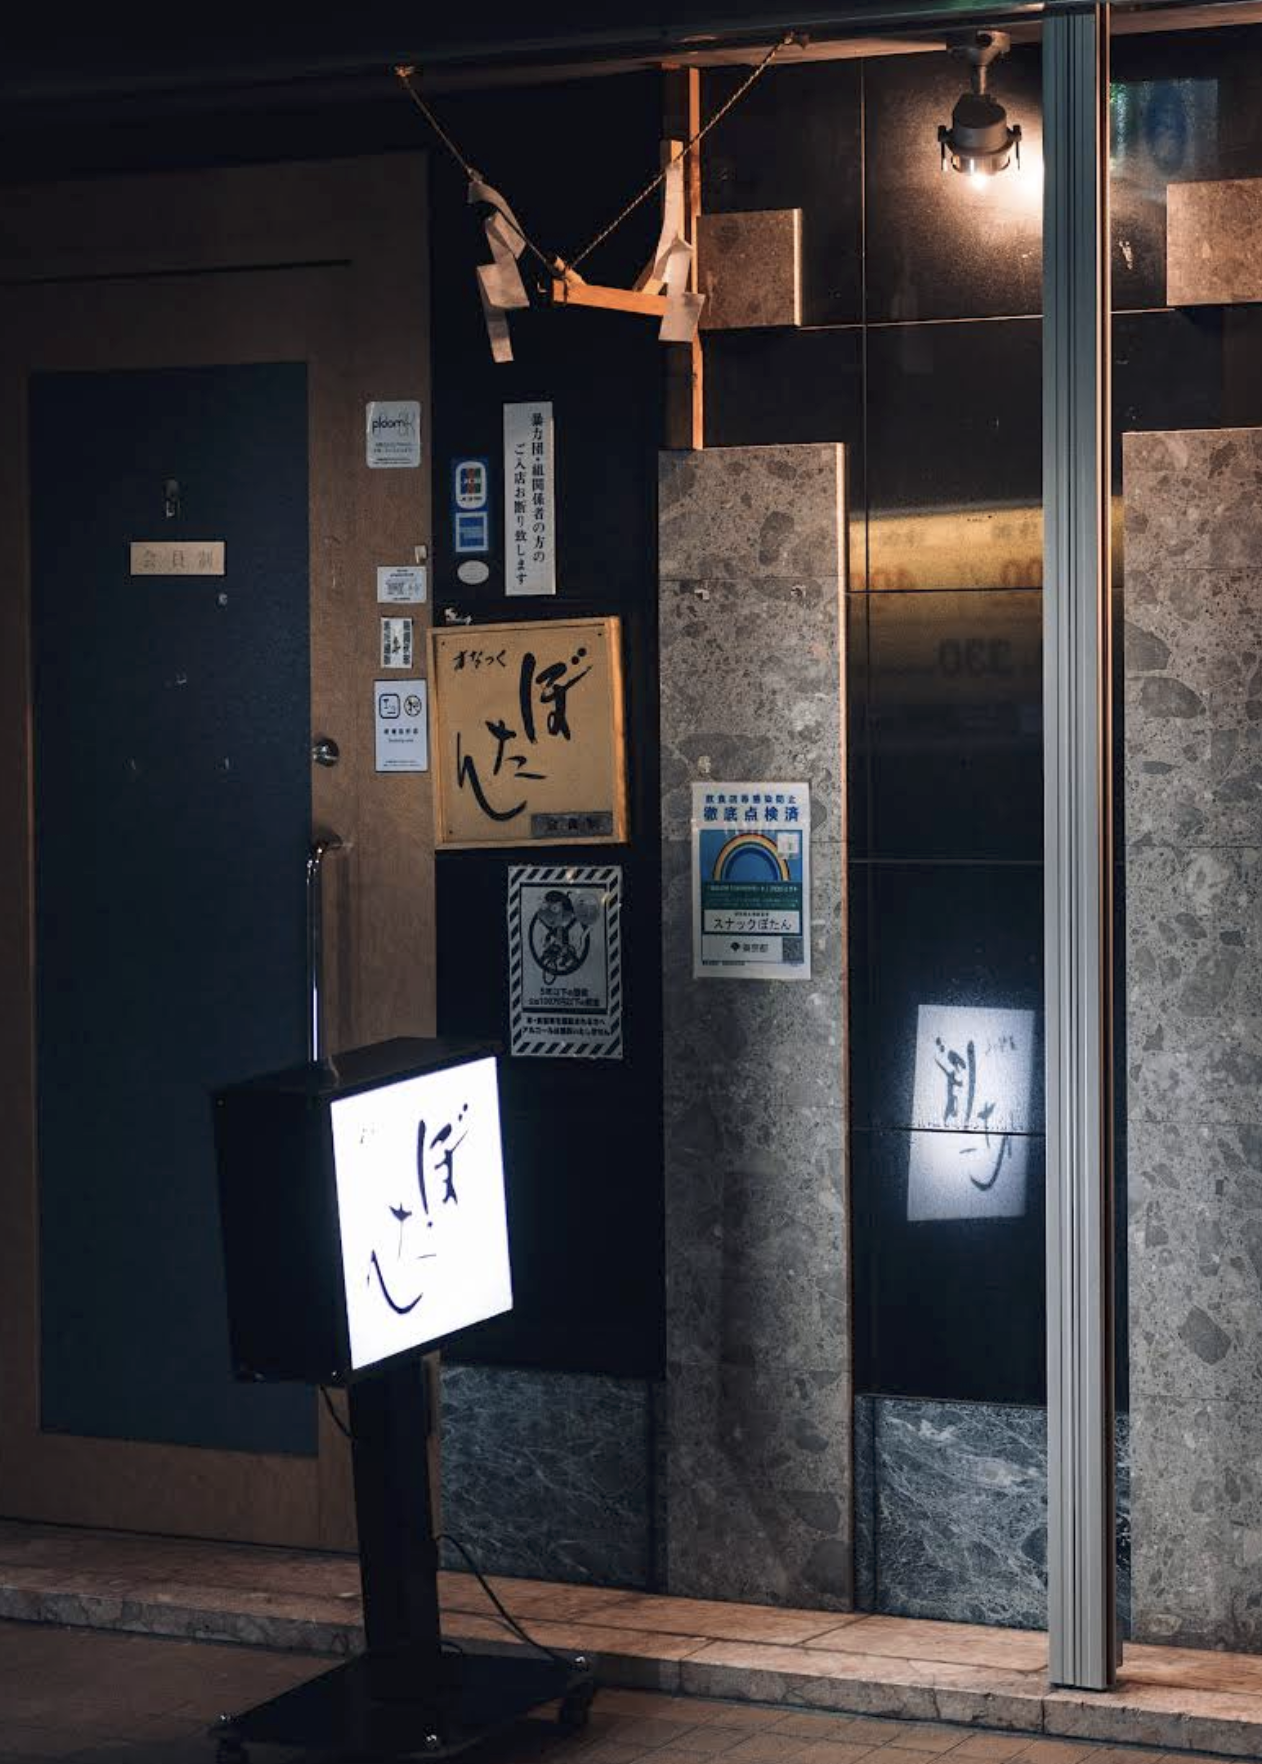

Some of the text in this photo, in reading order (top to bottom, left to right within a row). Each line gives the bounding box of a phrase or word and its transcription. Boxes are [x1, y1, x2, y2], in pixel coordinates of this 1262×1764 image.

[513, 442, 528, 586] ご入店お断り致します
[531, 412, 546, 563] 暴力団・組関係者の方の
[456, 647, 594, 822] ぼたん
[703, 806, 799, 822] 徹底点検済
[713, 917, 793, 931] スナックぼたん
